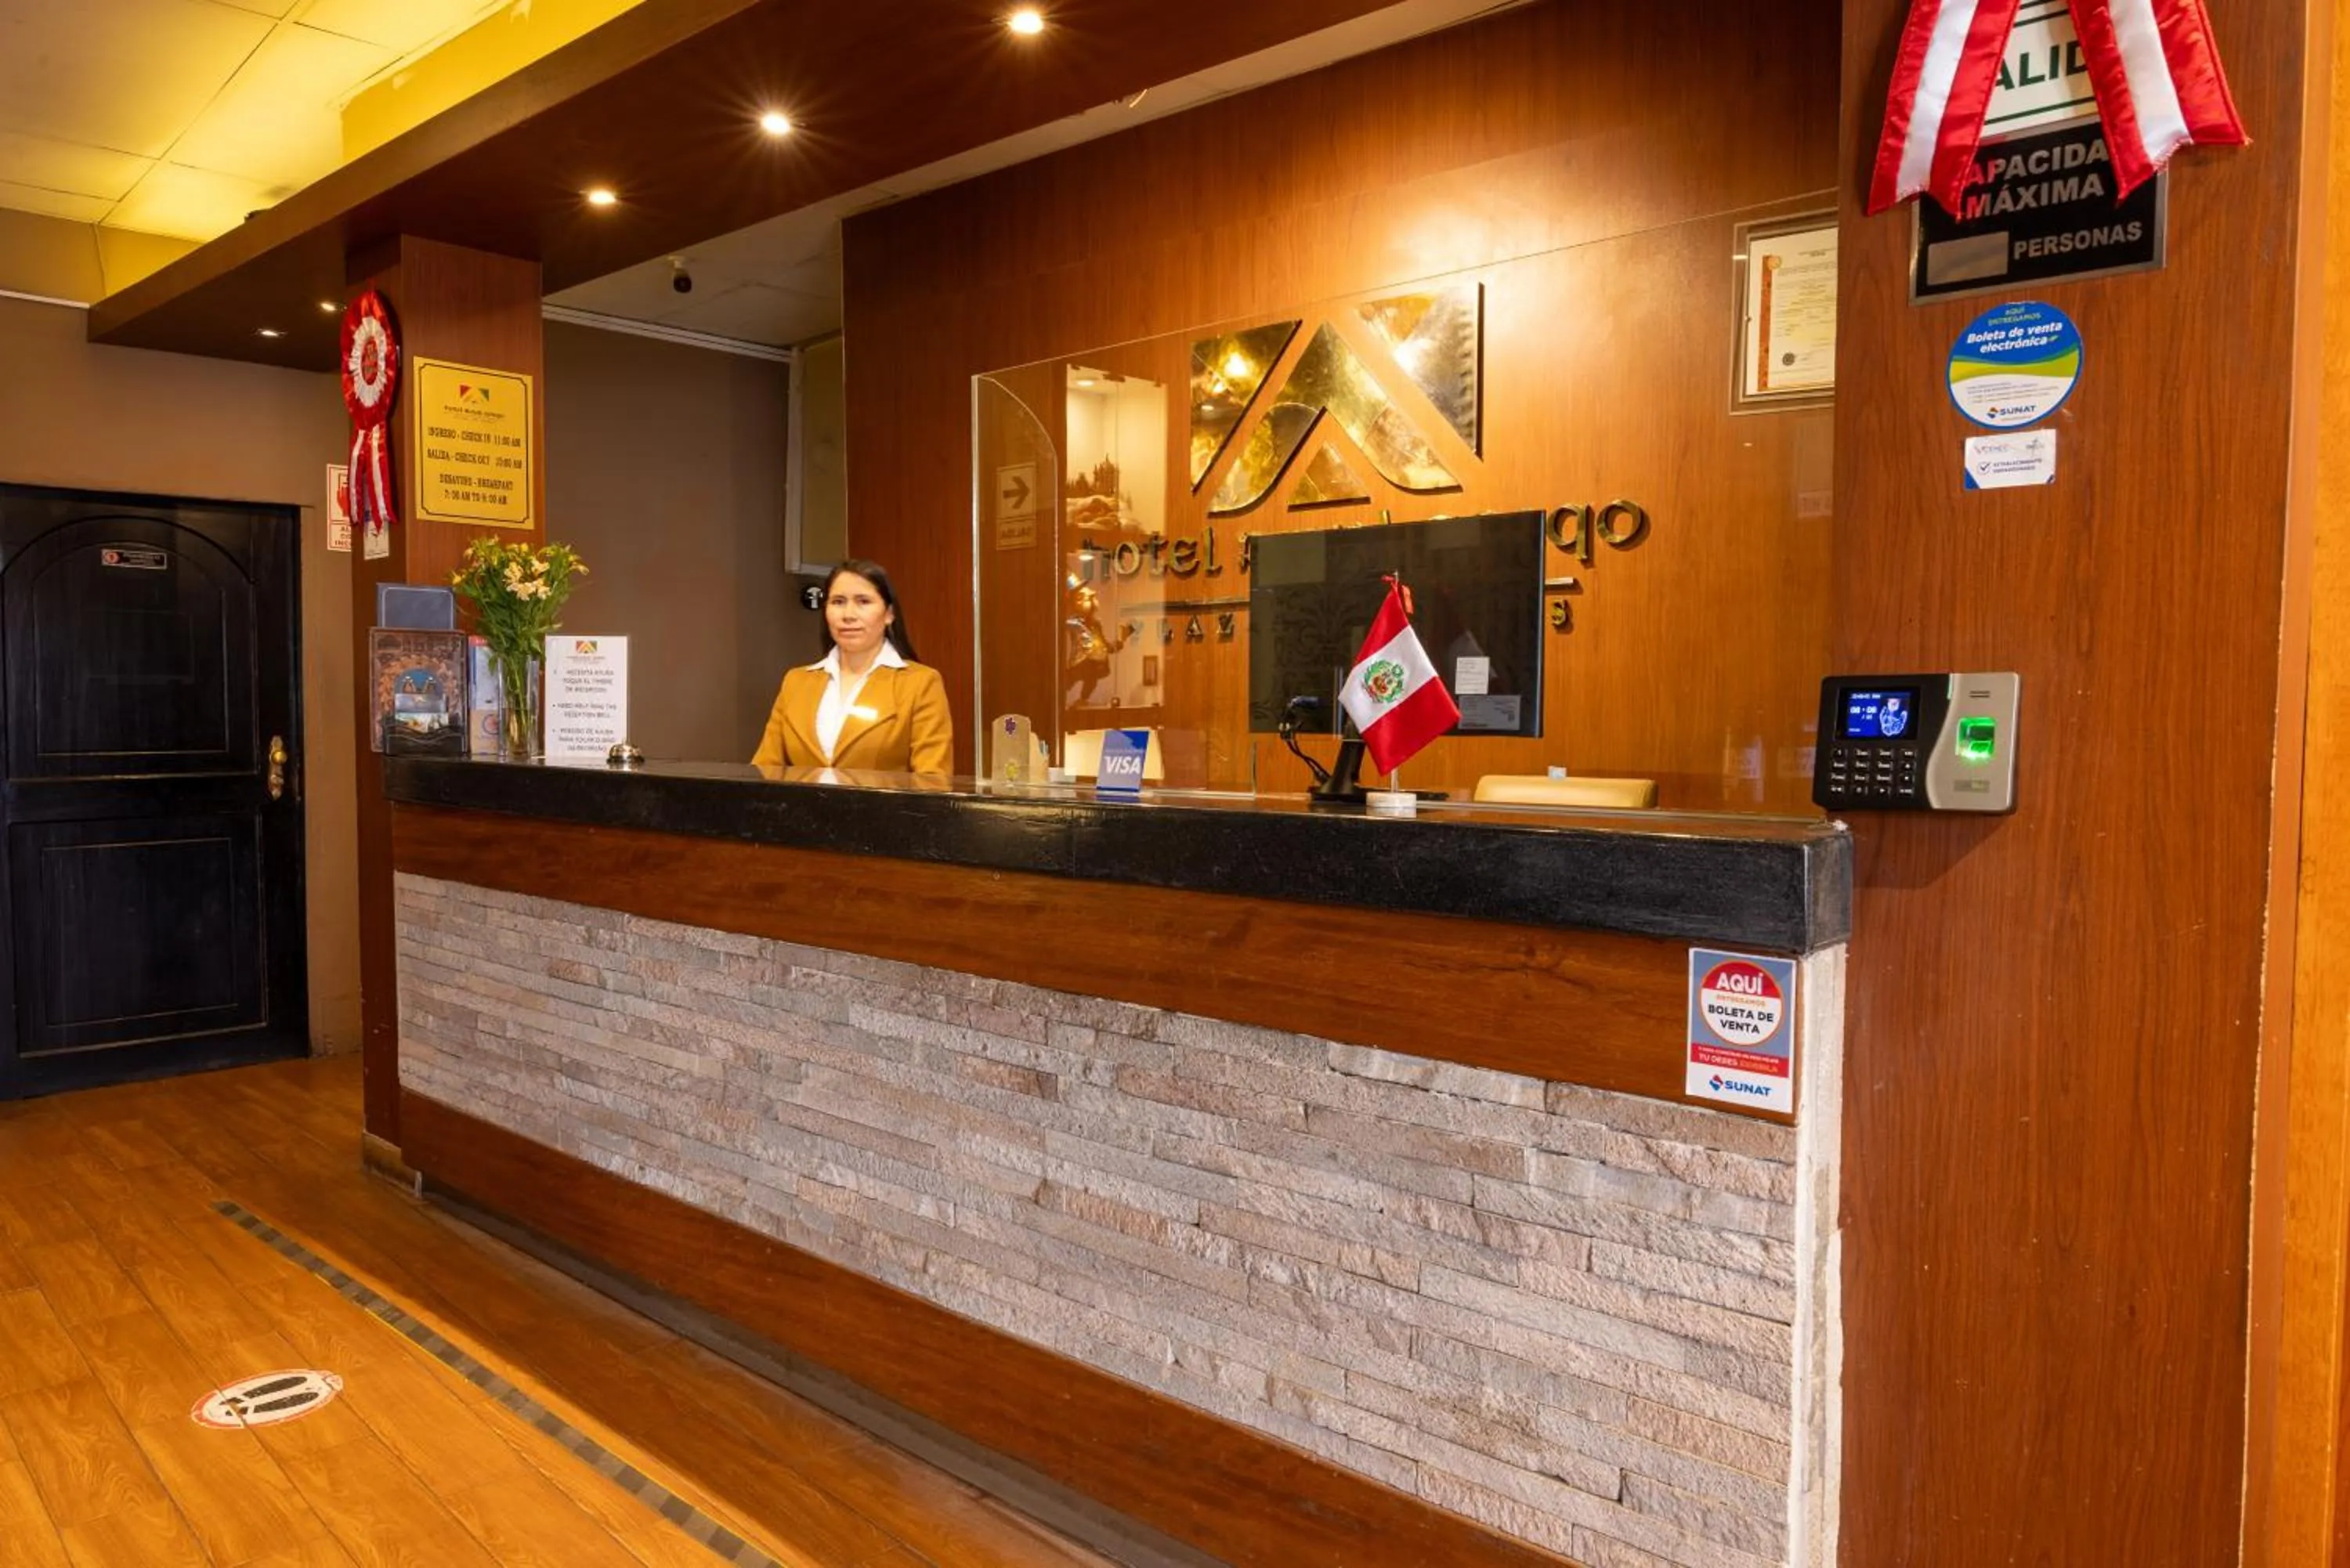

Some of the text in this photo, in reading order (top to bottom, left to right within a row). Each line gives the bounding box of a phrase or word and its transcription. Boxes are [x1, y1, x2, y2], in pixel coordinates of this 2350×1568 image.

[1995, 40, 2088, 90] ALID
[1966, 139, 2110, 187] APACIDA
[1966, 173, 2105, 219] MÁXIMA
[2013, 221, 2142, 260] PERSONAS
[1966, 322, 2063, 344] Boleta de venta
[1979, 336, 2048, 353] electrónica
[2000, 405, 2036, 416] SUNAT
[1131, 612, 1235, 642] PLAZ
[1104, 755, 1142, 775] VISA
[1716, 971, 1763, 995] AQUÍ
[1708, 1003, 1774, 1022] BOLETA DE
[1719, 1019, 1761, 1035] VENTA
[1698, 1053, 1711, 1063] TU
[1711, 1055, 1738, 1066] DEBES
[1724, 1080, 1773, 1097] SUNAT
